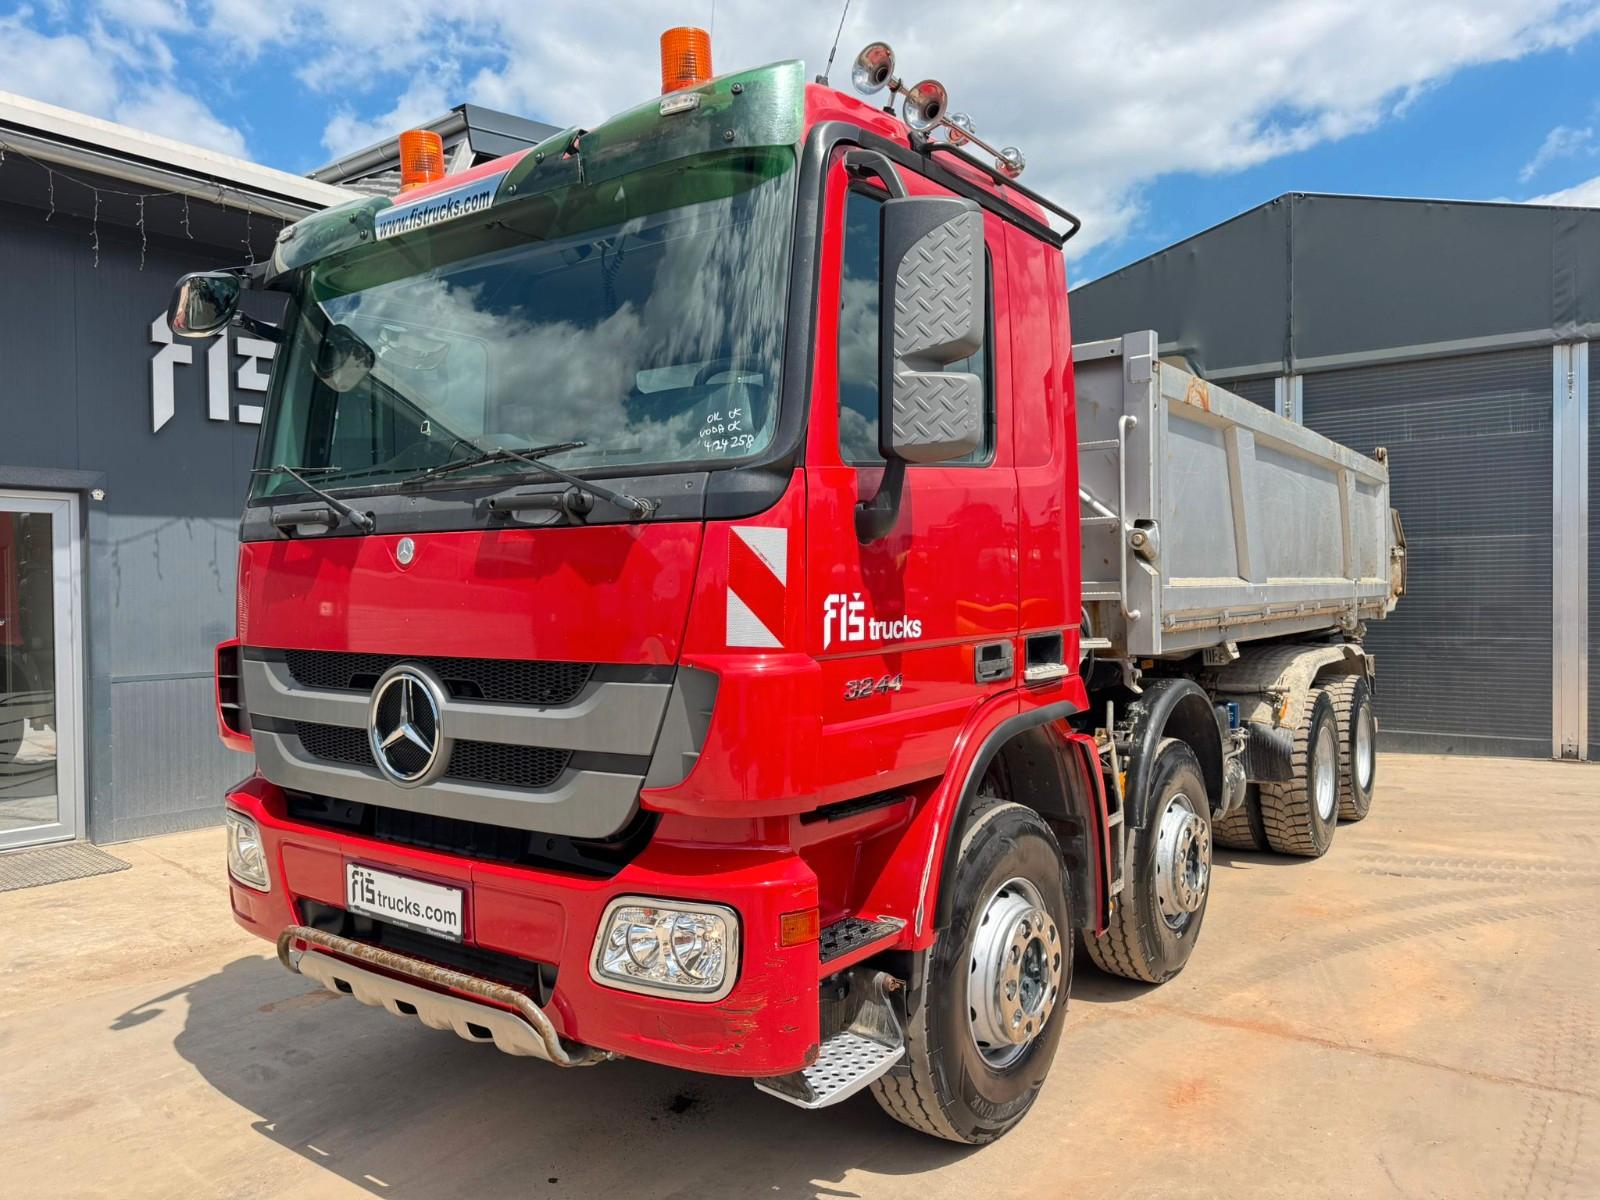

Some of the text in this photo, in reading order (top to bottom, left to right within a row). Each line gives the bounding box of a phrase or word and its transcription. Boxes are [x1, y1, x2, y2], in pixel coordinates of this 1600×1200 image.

[380, 190, 490, 238] www.fistrucks.com
[868, 614, 922, 641] trucks
[844, 673, 903, 701] 3244
[377, 890, 457, 927] trucks.com
